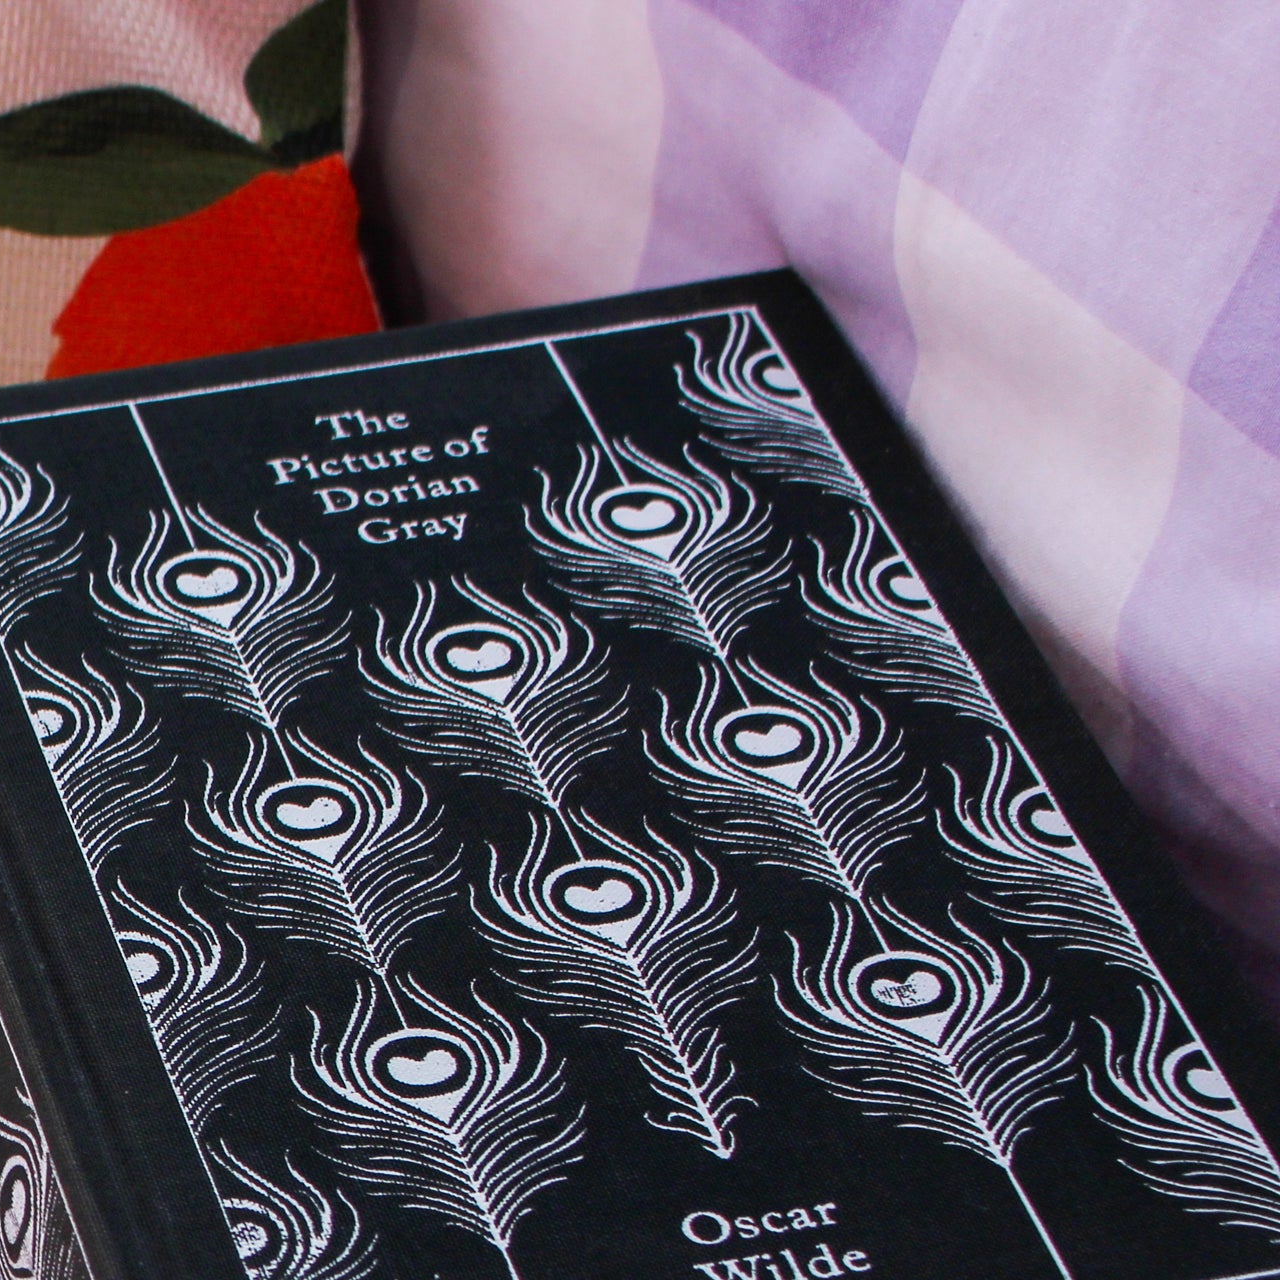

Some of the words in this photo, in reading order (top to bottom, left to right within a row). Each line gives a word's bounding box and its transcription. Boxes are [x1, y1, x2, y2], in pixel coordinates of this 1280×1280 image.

[314, 408, 411, 442] The
[267, 434, 435, 485] Picture
[443, 426, 492, 460] of
[312, 467, 481, 516] Dorian
[357, 511, 469, 546] Gray
[681, 1201, 839, 1246] Oscar
